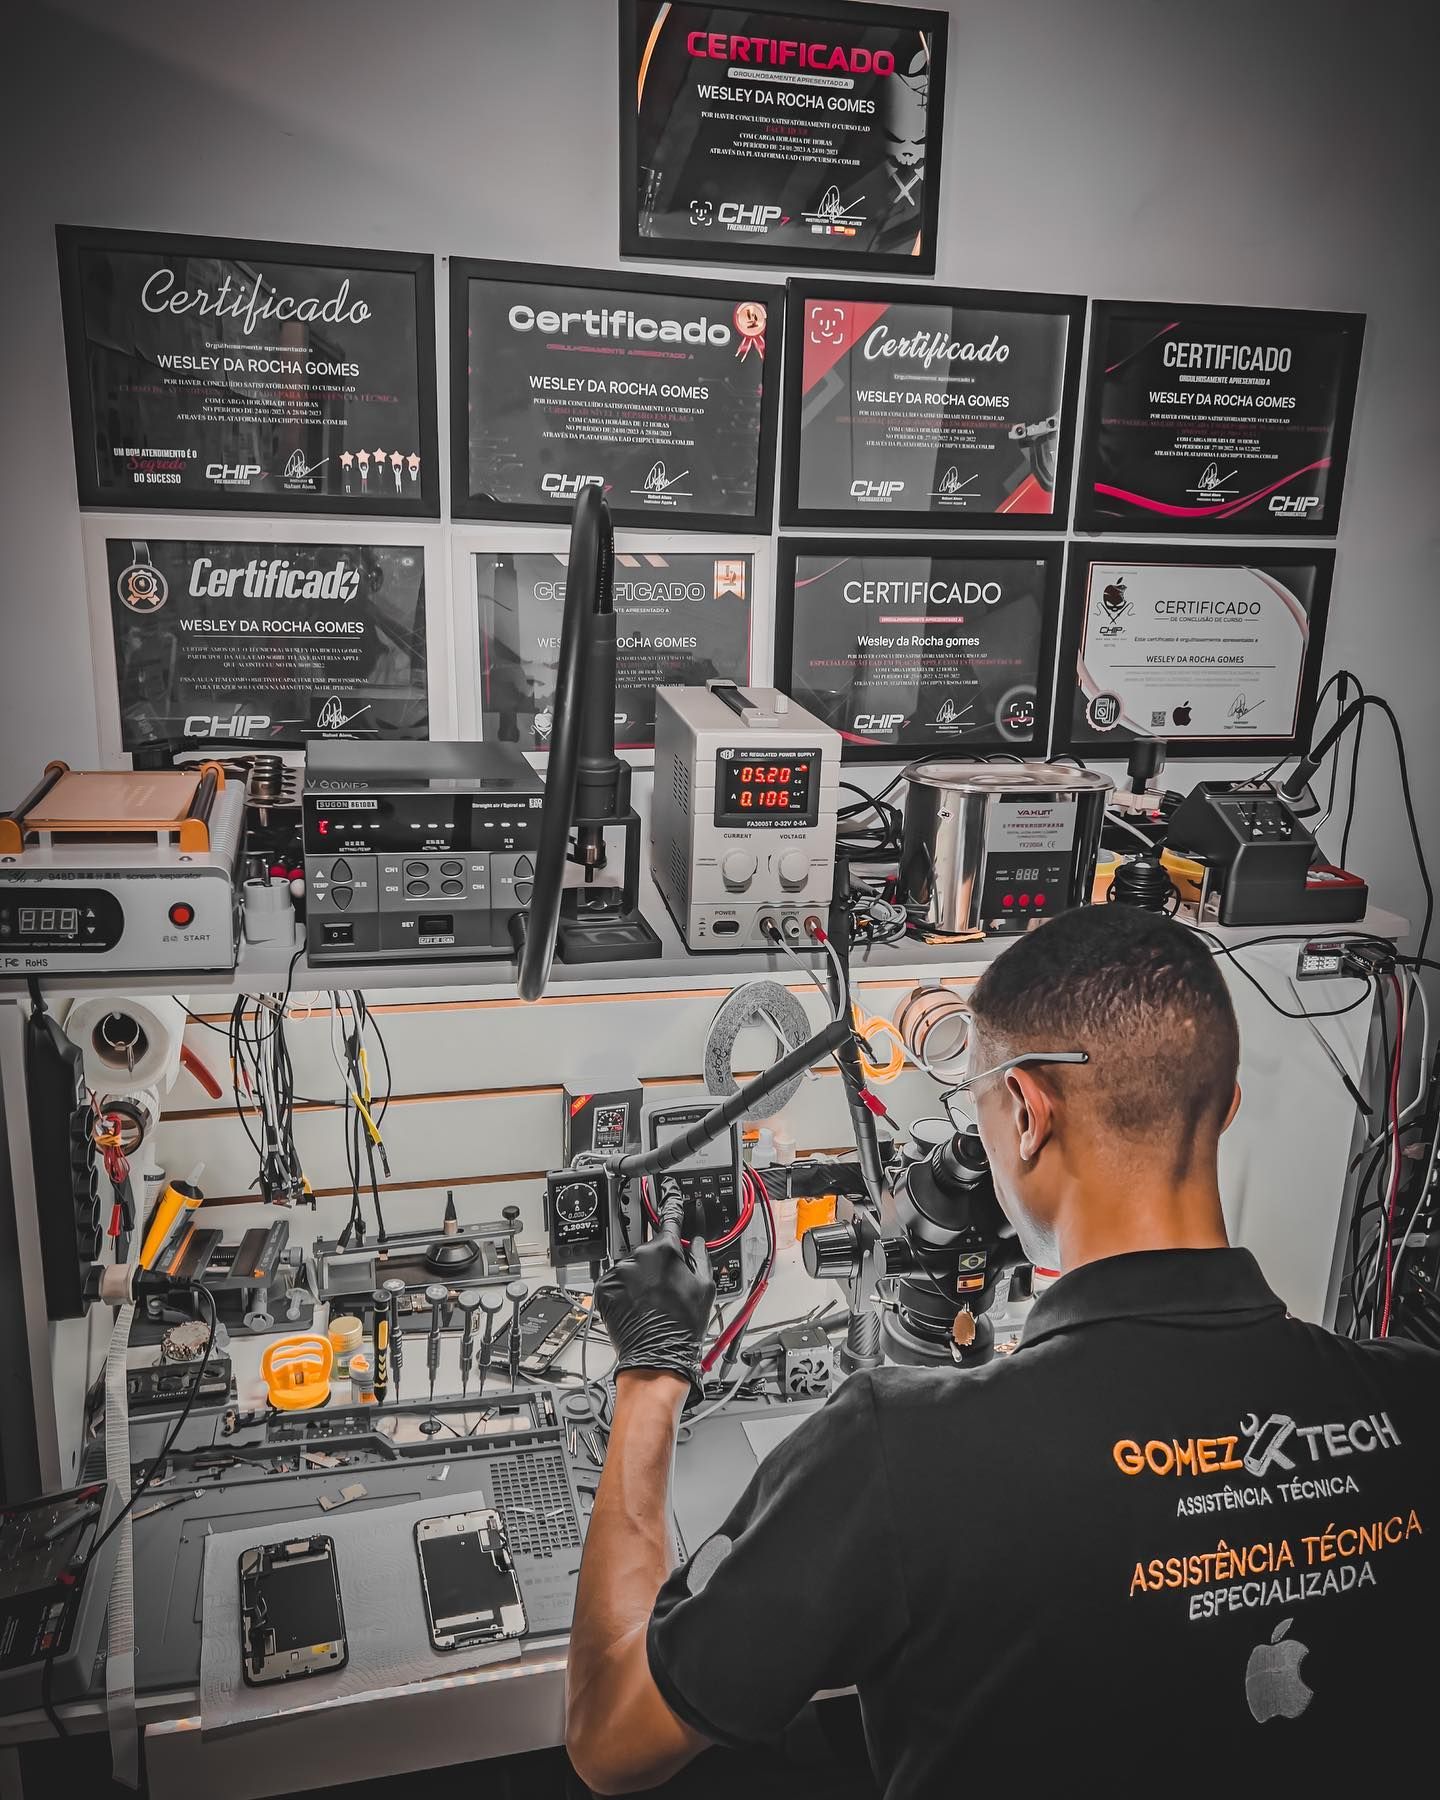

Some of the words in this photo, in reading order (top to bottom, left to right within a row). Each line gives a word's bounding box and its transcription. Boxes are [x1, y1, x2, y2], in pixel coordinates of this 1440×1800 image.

[687, 31, 895, 76] CERTIFICADO
[698, 85, 752, 103] WESLEY
[755, 90, 774, 105] DA
[777, 92, 824, 109] ROCHA
[828, 96, 875, 114] GOMES
[701, 111, 713, 119] POR
[740, 133, 754, 141] COM
[755, 134, 775, 142] CARGA
[141, 268, 371, 335] Certificado
[508, 304, 731, 347] Certificado
[863, 325, 1010, 369] Certificado
[157, 354, 220, 370] WESLEY
[223, 358, 245, 372] DA
[248, 359, 302, 374] ROCHA
[305, 362, 360, 377] GOMES
[1162, 342, 1292, 373] CERTIFICADO
[530, 376, 585, 392] WESLEY
[588, 379, 606, 393] DA
[610, 381, 657, 396] ROCHA
[661, 384, 709, 400] GOMES
[857, 390, 905, 404] WESLEY
[906, 392, 922, 404] DA
[925, 393, 965, 406] ROCHA
[968, 394, 1009, 408] GOMES
[1149, 392, 1195, 405] WESLEY
[1196, 393, 1212, 406] DA
[1214, 394, 1253, 407] ROCHA
[1256, 395, 1296, 408] GOMES
[113, 448, 124, 456] UM
[141, 449, 186, 458] ATENDIMENTO
[127, 456, 187, 471] Segredo
[133, 473, 145, 483] DO
[146, 473, 181, 484] SUCESSO
[188, 557, 361, 604] Certificado
[843, 581, 1002, 605] CERTIFICADO
[1154, 600, 1261, 616] CERTIFICADO
[180, 619, 237, 632] WESLEY
[240, 620, 260, 632] DA
[263, 620, 312, 633] ROCHA
[315, 621, 364, 633] GOMES
[654, 637, 697, 648] GOMES
[857, 635, 894, 648] Wesley
[896, 635, 909, 646] da
[912, 635, 943, 646] Rocha
[945, 637, 980, 648] gomes
[741, 767, 791, 783] 05.20
[740, 791, 789, 807] 0.106
[159, 872, 202, 881] separator
[183, 934, 211, 942] START
[25, 958, 48, 967] RoHS
[1113, 1435, 1243, 1477] GOMEZ
[1296, 1412, 1402, 1462] TECH
[1177, 1484, 1272, 1517] ASSISTÊNCIA
[1277, 1475, 1360, 1503] TÉCNICA
[1130, 1539, 1295, 1597] ASSISTÊNCIA
[1301, 1509, 1423, 1565] TÉCNICA
[1189, 1560, 1377, 1621] ESPECIALIZADA
